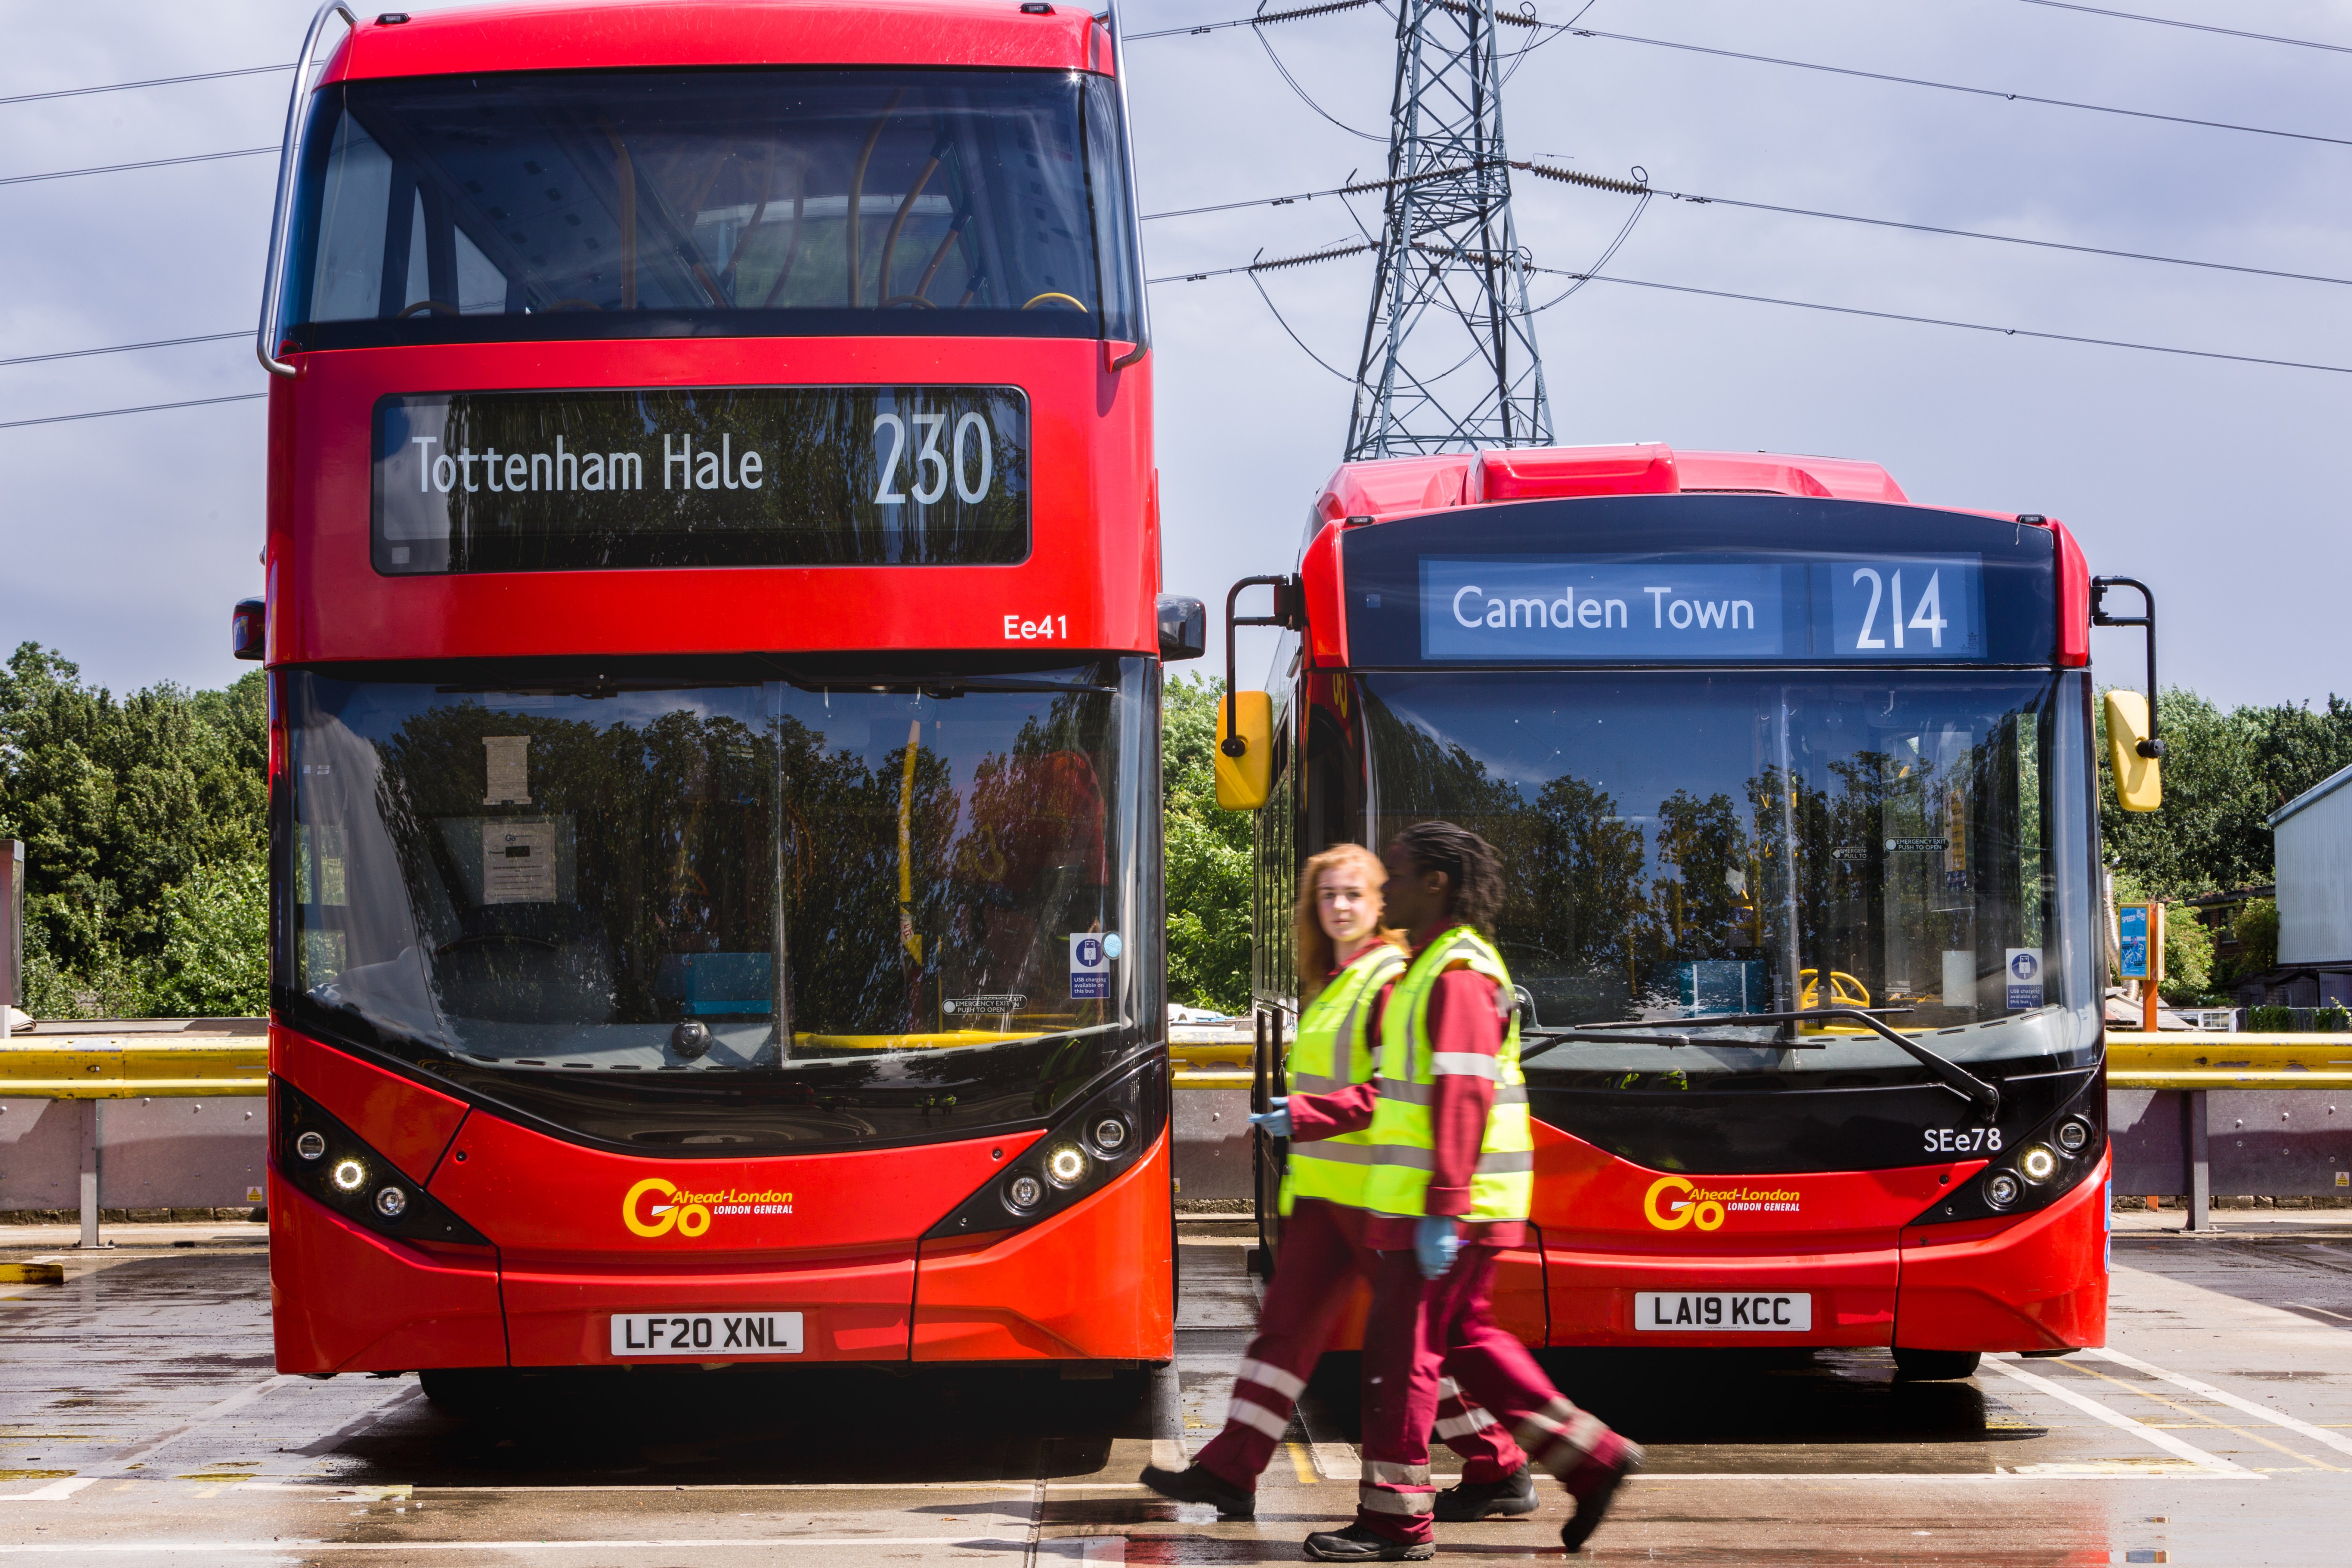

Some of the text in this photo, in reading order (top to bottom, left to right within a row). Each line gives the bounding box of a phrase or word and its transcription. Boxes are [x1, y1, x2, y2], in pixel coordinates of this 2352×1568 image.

[412, 433, 763, 493] Tottenham Hale
[874, 412, 992, 505] 230
[1453, 585, 1755, 629] Camden Town
[1853, 567, 1947, 649] 214
[1004, 615, 1066, 639] Ee41
[1923, 1127, 2002, 1152] SEe78
[622, 1178, 793, 1237] Go Ahead-London
[714, 1204, 793, 1215] LONDON GENERAL
[1644, 1176, 1800, 1231] Go Ahead-London
[1727, 1202, 1800, 1211] LONDON GENERAL
[1654, 1297, 1791, 1325] LA19 KCC
[626, 1317, 787, 1349] LF20 XNL
